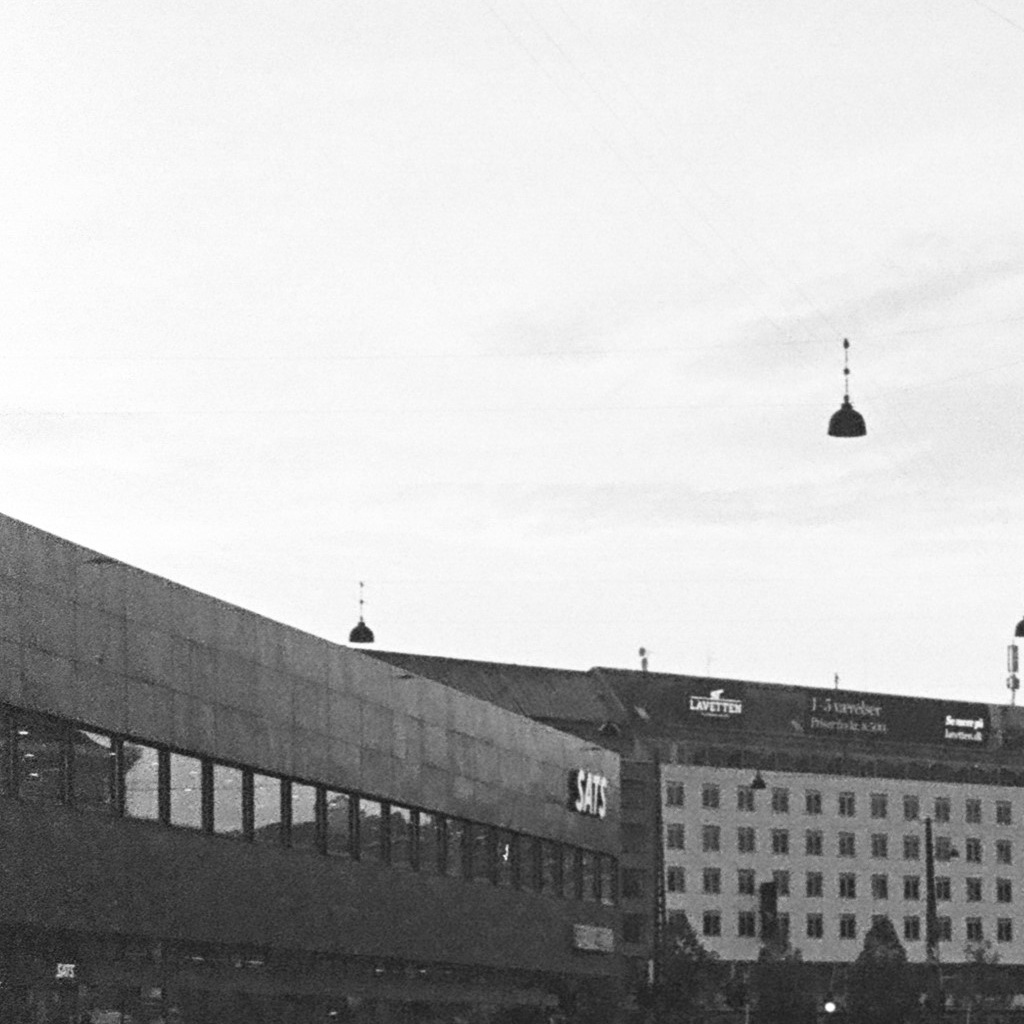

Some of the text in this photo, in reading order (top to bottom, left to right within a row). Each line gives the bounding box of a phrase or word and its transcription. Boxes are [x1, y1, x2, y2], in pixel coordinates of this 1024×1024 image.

[689, 699, 742, 714] LAVETTEN
[575, 769, 607, 820] SATS
[55, 963, 76, 978] SATS
